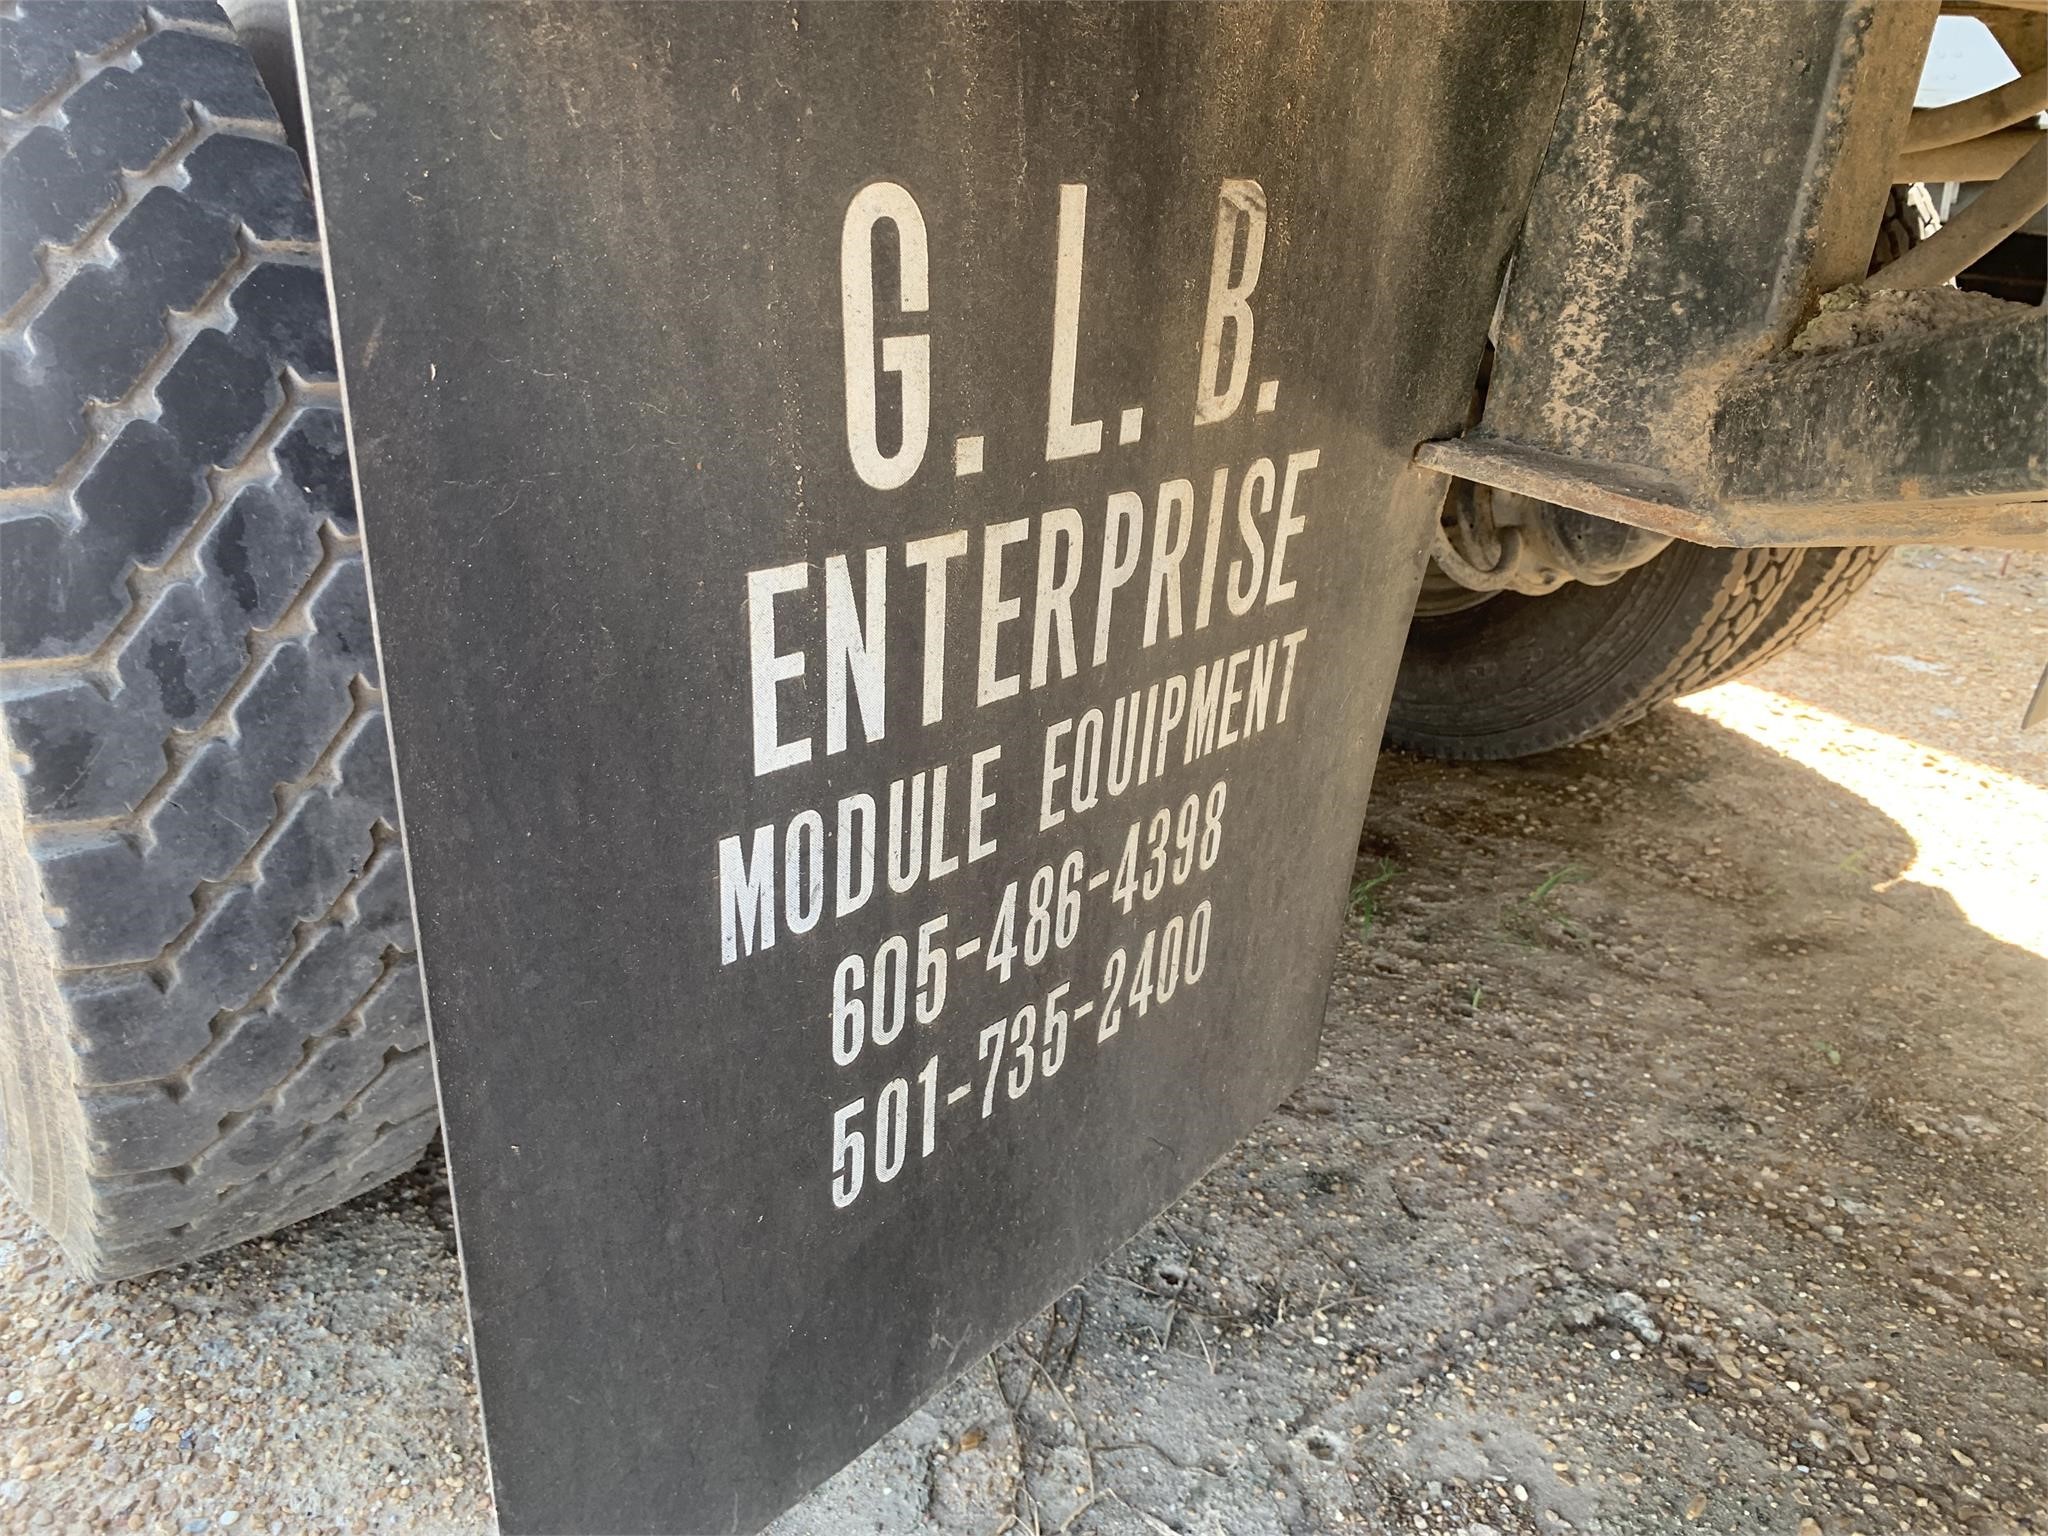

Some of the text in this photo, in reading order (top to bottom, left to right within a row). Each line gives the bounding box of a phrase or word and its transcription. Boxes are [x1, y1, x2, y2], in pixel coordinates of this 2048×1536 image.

[746, 449, 1321, 777] ENTERPRISE
[718, 627, 1308, 966] MODULE EQUIPMENT
[832, 781, 1226, 1067] 605-486-4398
[831, 900, 1212, 1209] 501-735-2400
